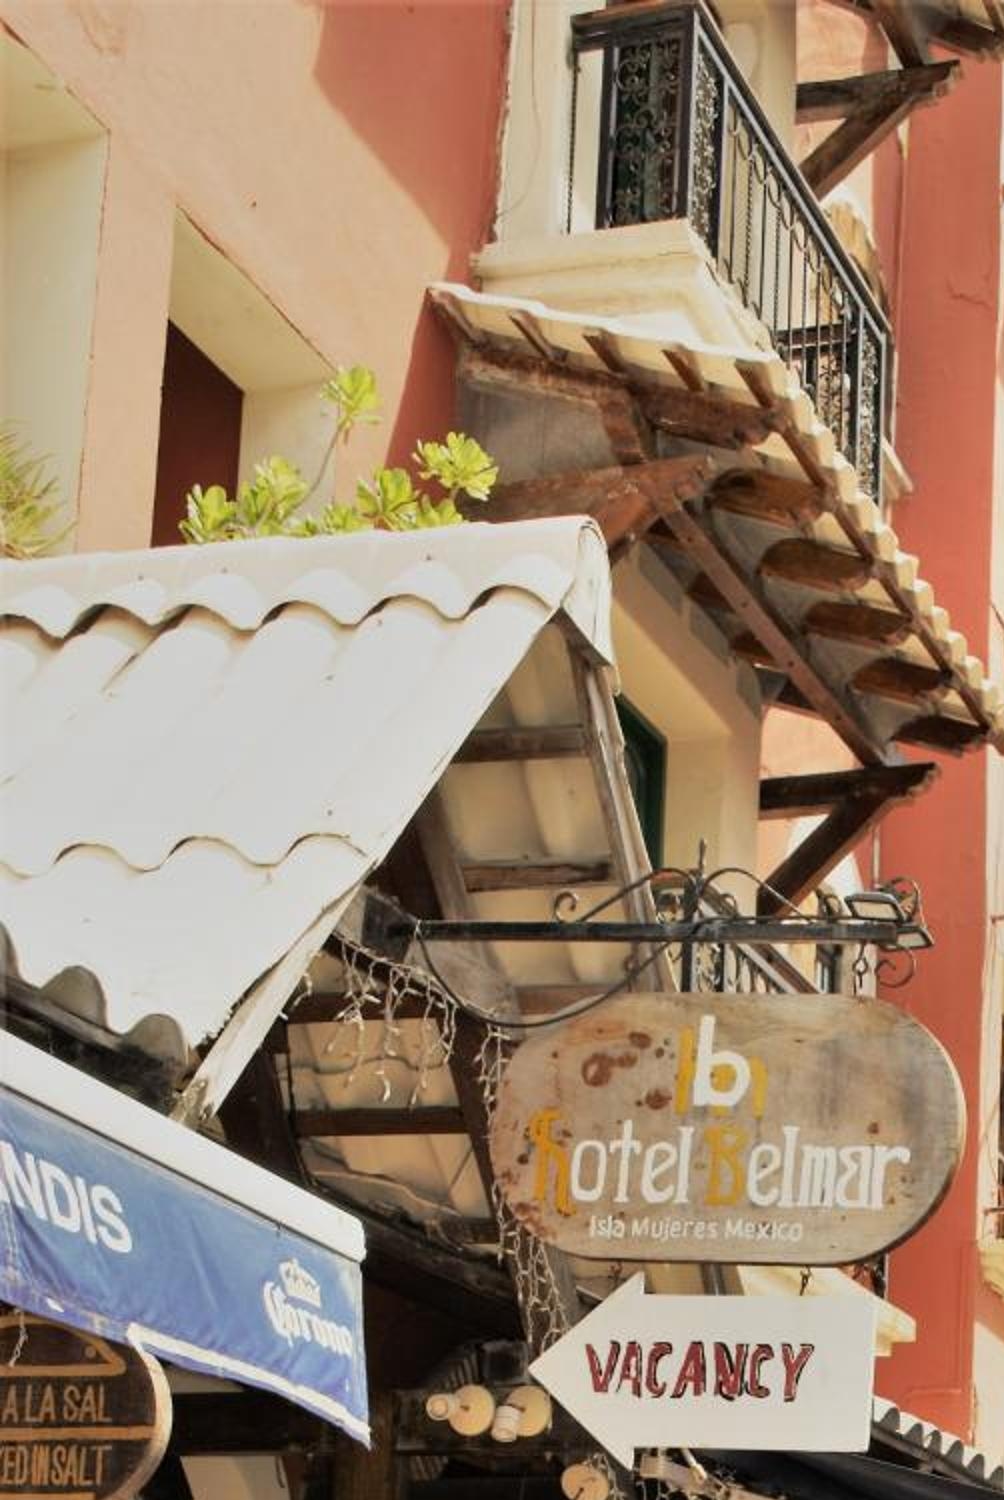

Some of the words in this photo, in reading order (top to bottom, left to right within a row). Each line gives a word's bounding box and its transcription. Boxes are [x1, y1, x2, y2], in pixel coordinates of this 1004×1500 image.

[0, 1138, 133, 1253] NDIS
[590, 1214, 626, 1240] Isla
[631, 1216, 720, 1243] Mujeres
[724, 1217, 804, 1243] Mexico
[584, 1338, 815, 1402] VACANCY
[24, 1384, 57, 1422] LA
[63, 1384, 113, 1423] SAL
[0, 1446, 28, 1486] ED
[51, 1445, 113, 1486] SALT
